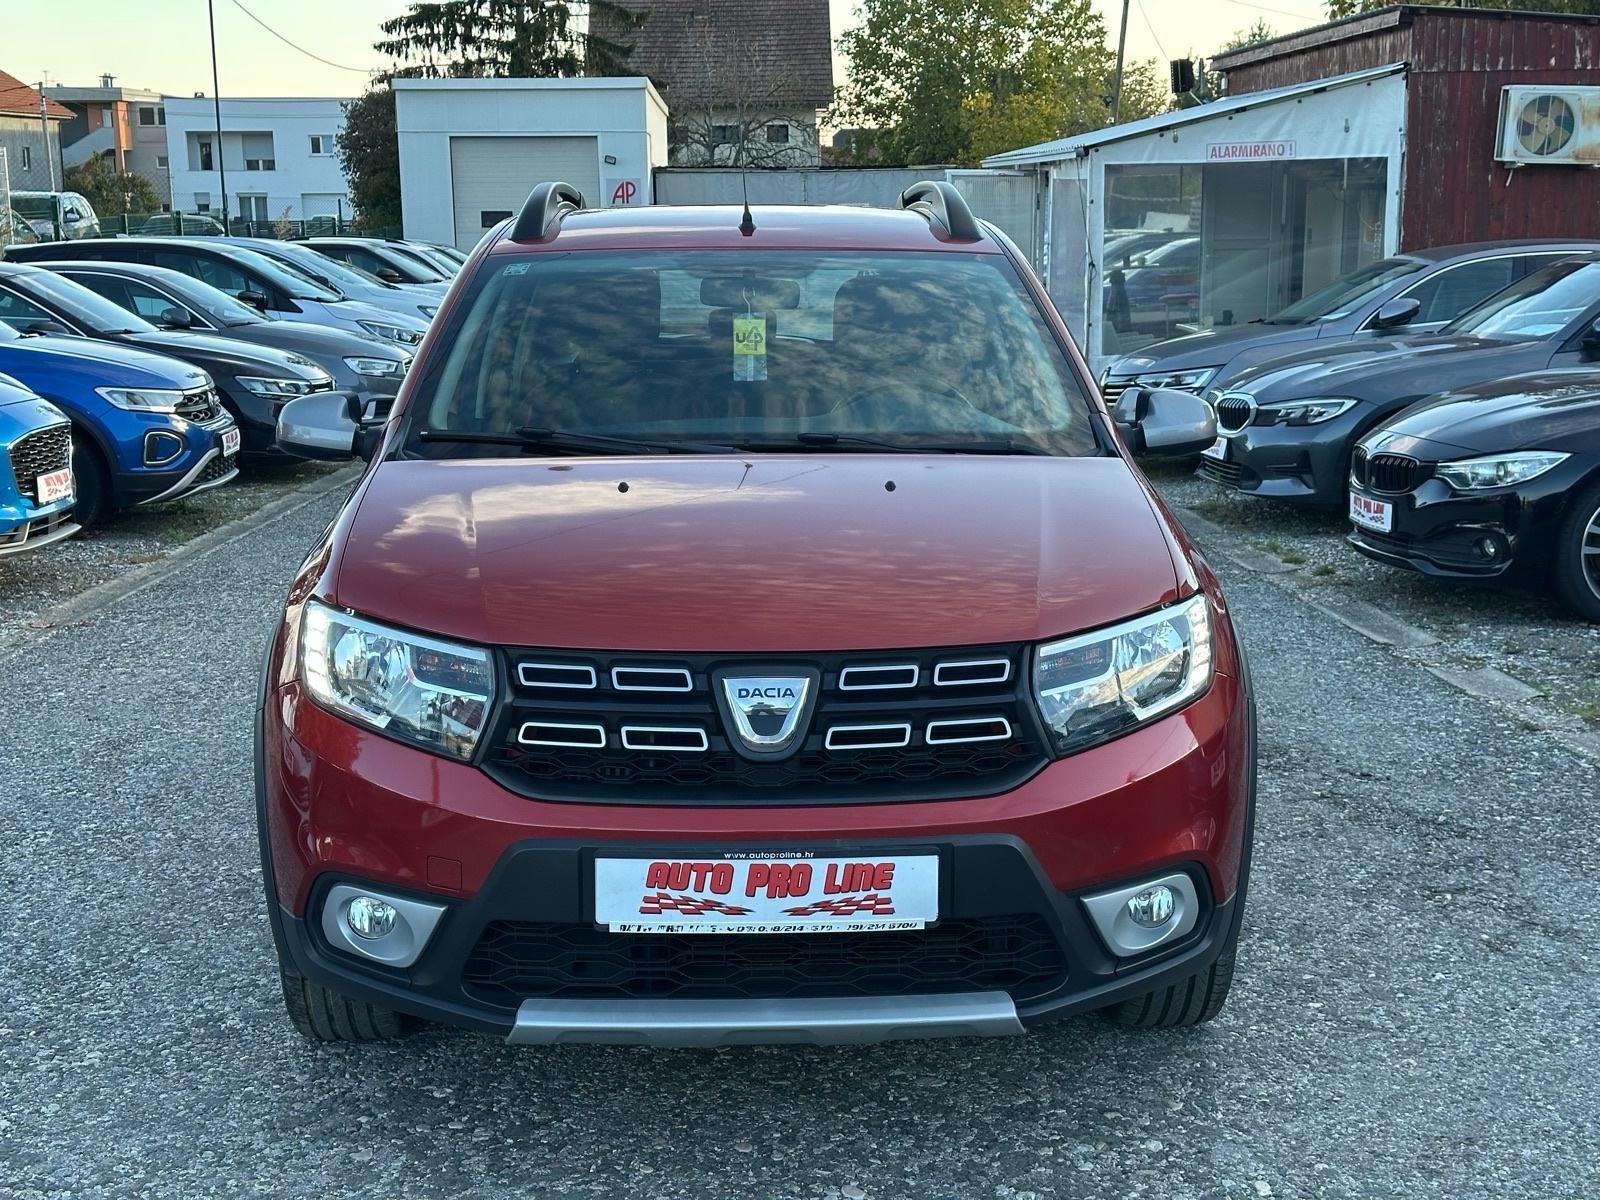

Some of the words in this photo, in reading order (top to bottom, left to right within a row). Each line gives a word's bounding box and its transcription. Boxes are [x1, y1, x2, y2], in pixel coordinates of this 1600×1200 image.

[1210, 144, 1285, 159] ALARMIRANO
[612, 181, 636, 204] AP
[738, 688, 795, 698] DACIA
[645, 862, 735, 895] AUTO
[745, 863, 813, 899] PRO
[823, 863, 896, 895] LINE
